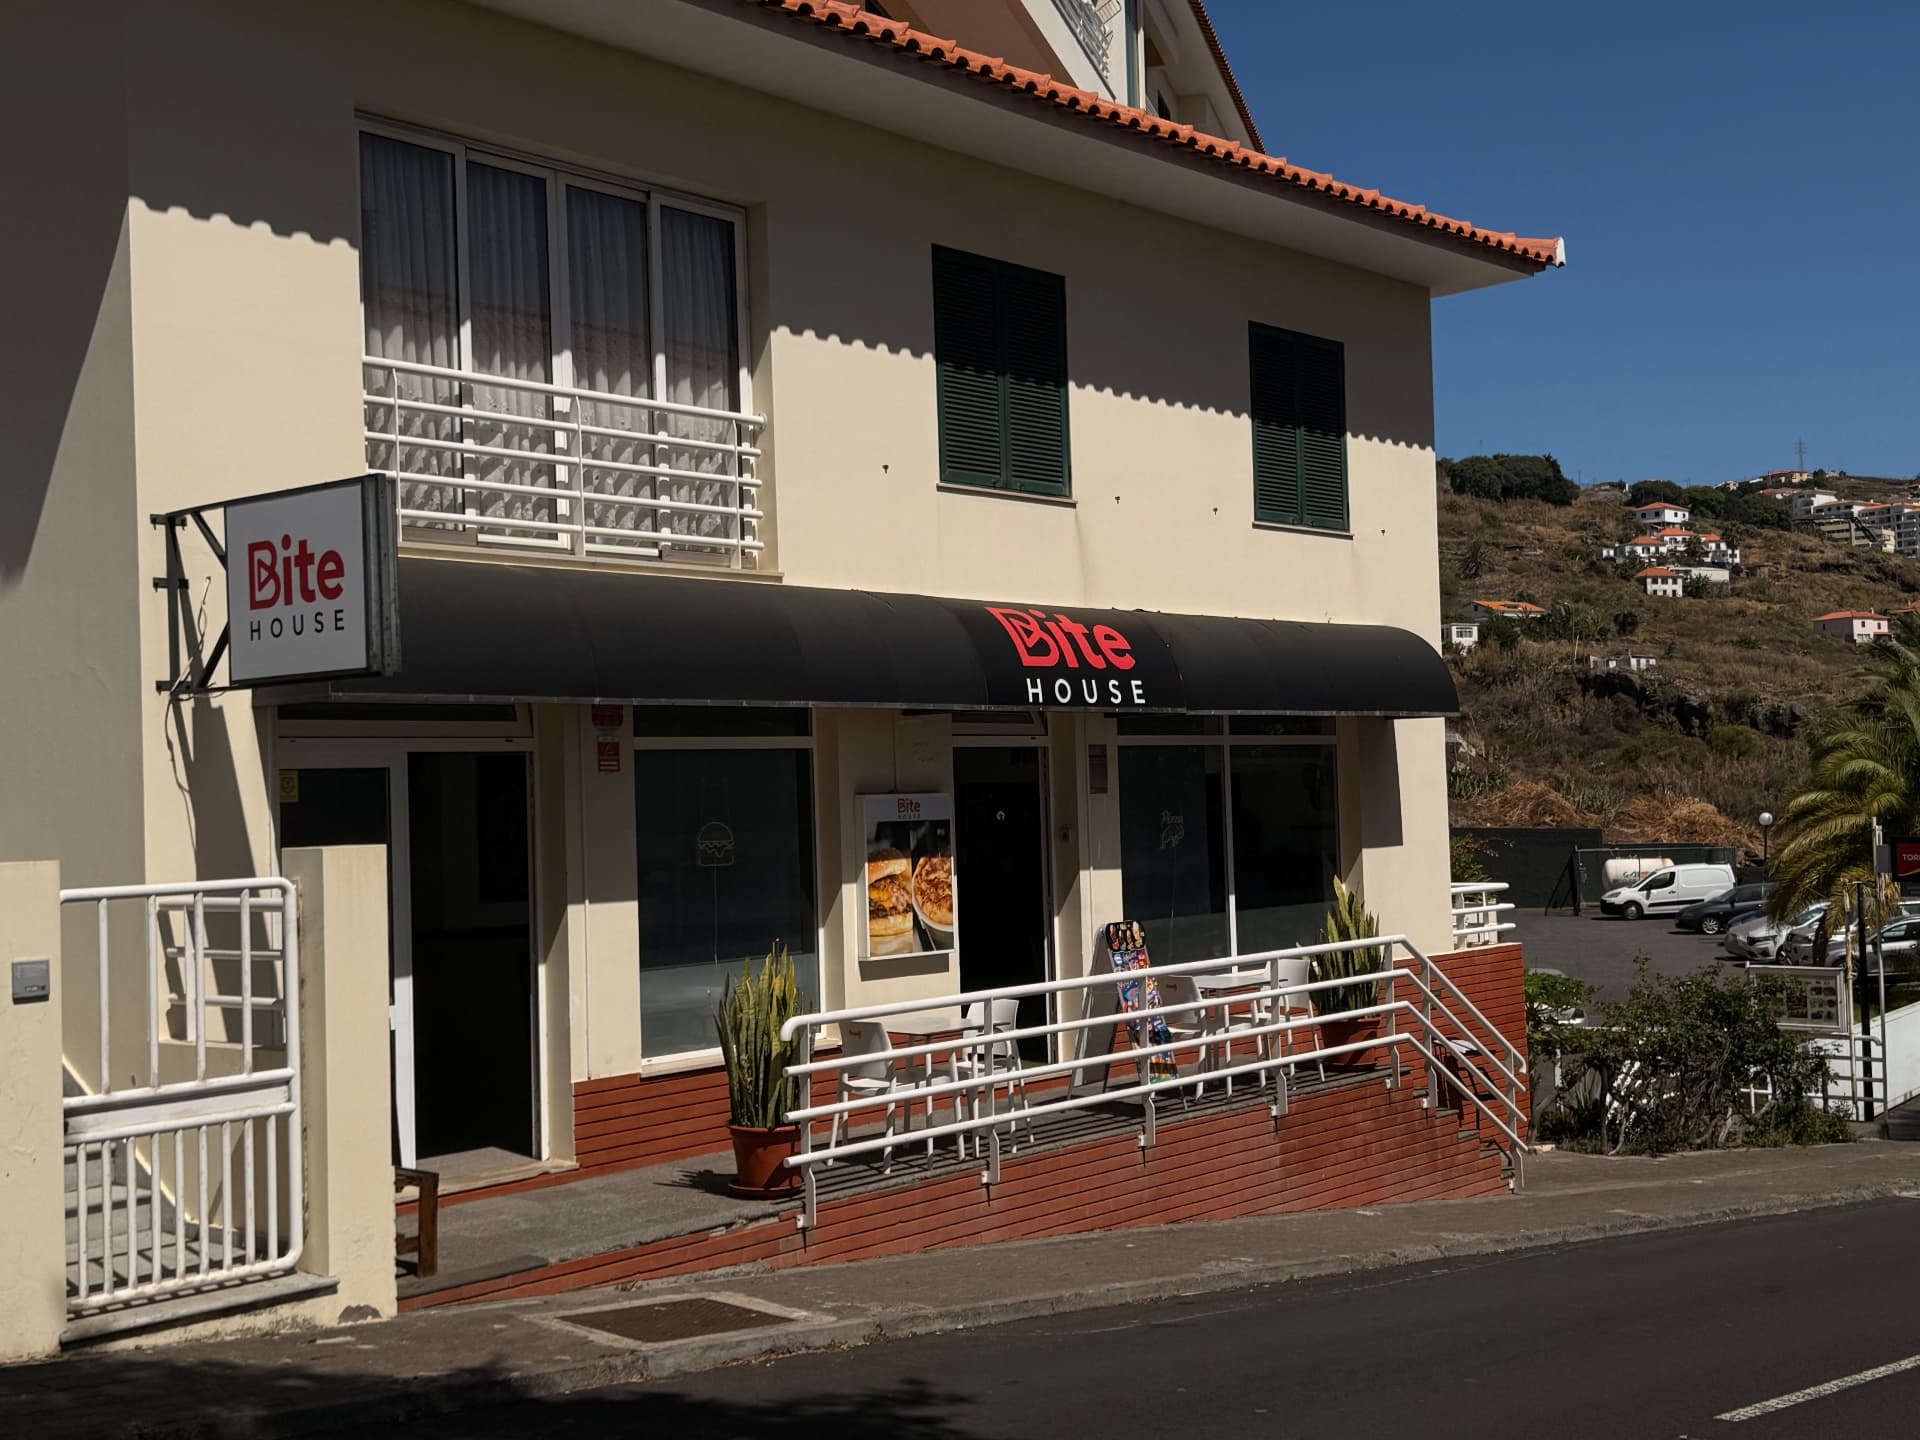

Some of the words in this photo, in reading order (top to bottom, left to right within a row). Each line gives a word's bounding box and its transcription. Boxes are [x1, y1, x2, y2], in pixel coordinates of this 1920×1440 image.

[247, 533, 345, 611] Bite
[250, 609, 345, 641] HOUSE
[984, 606, 1136, 670] Bite
[1026, 677, 1146, 704] HOUSE
[897, 797, 921, 813] Bite
